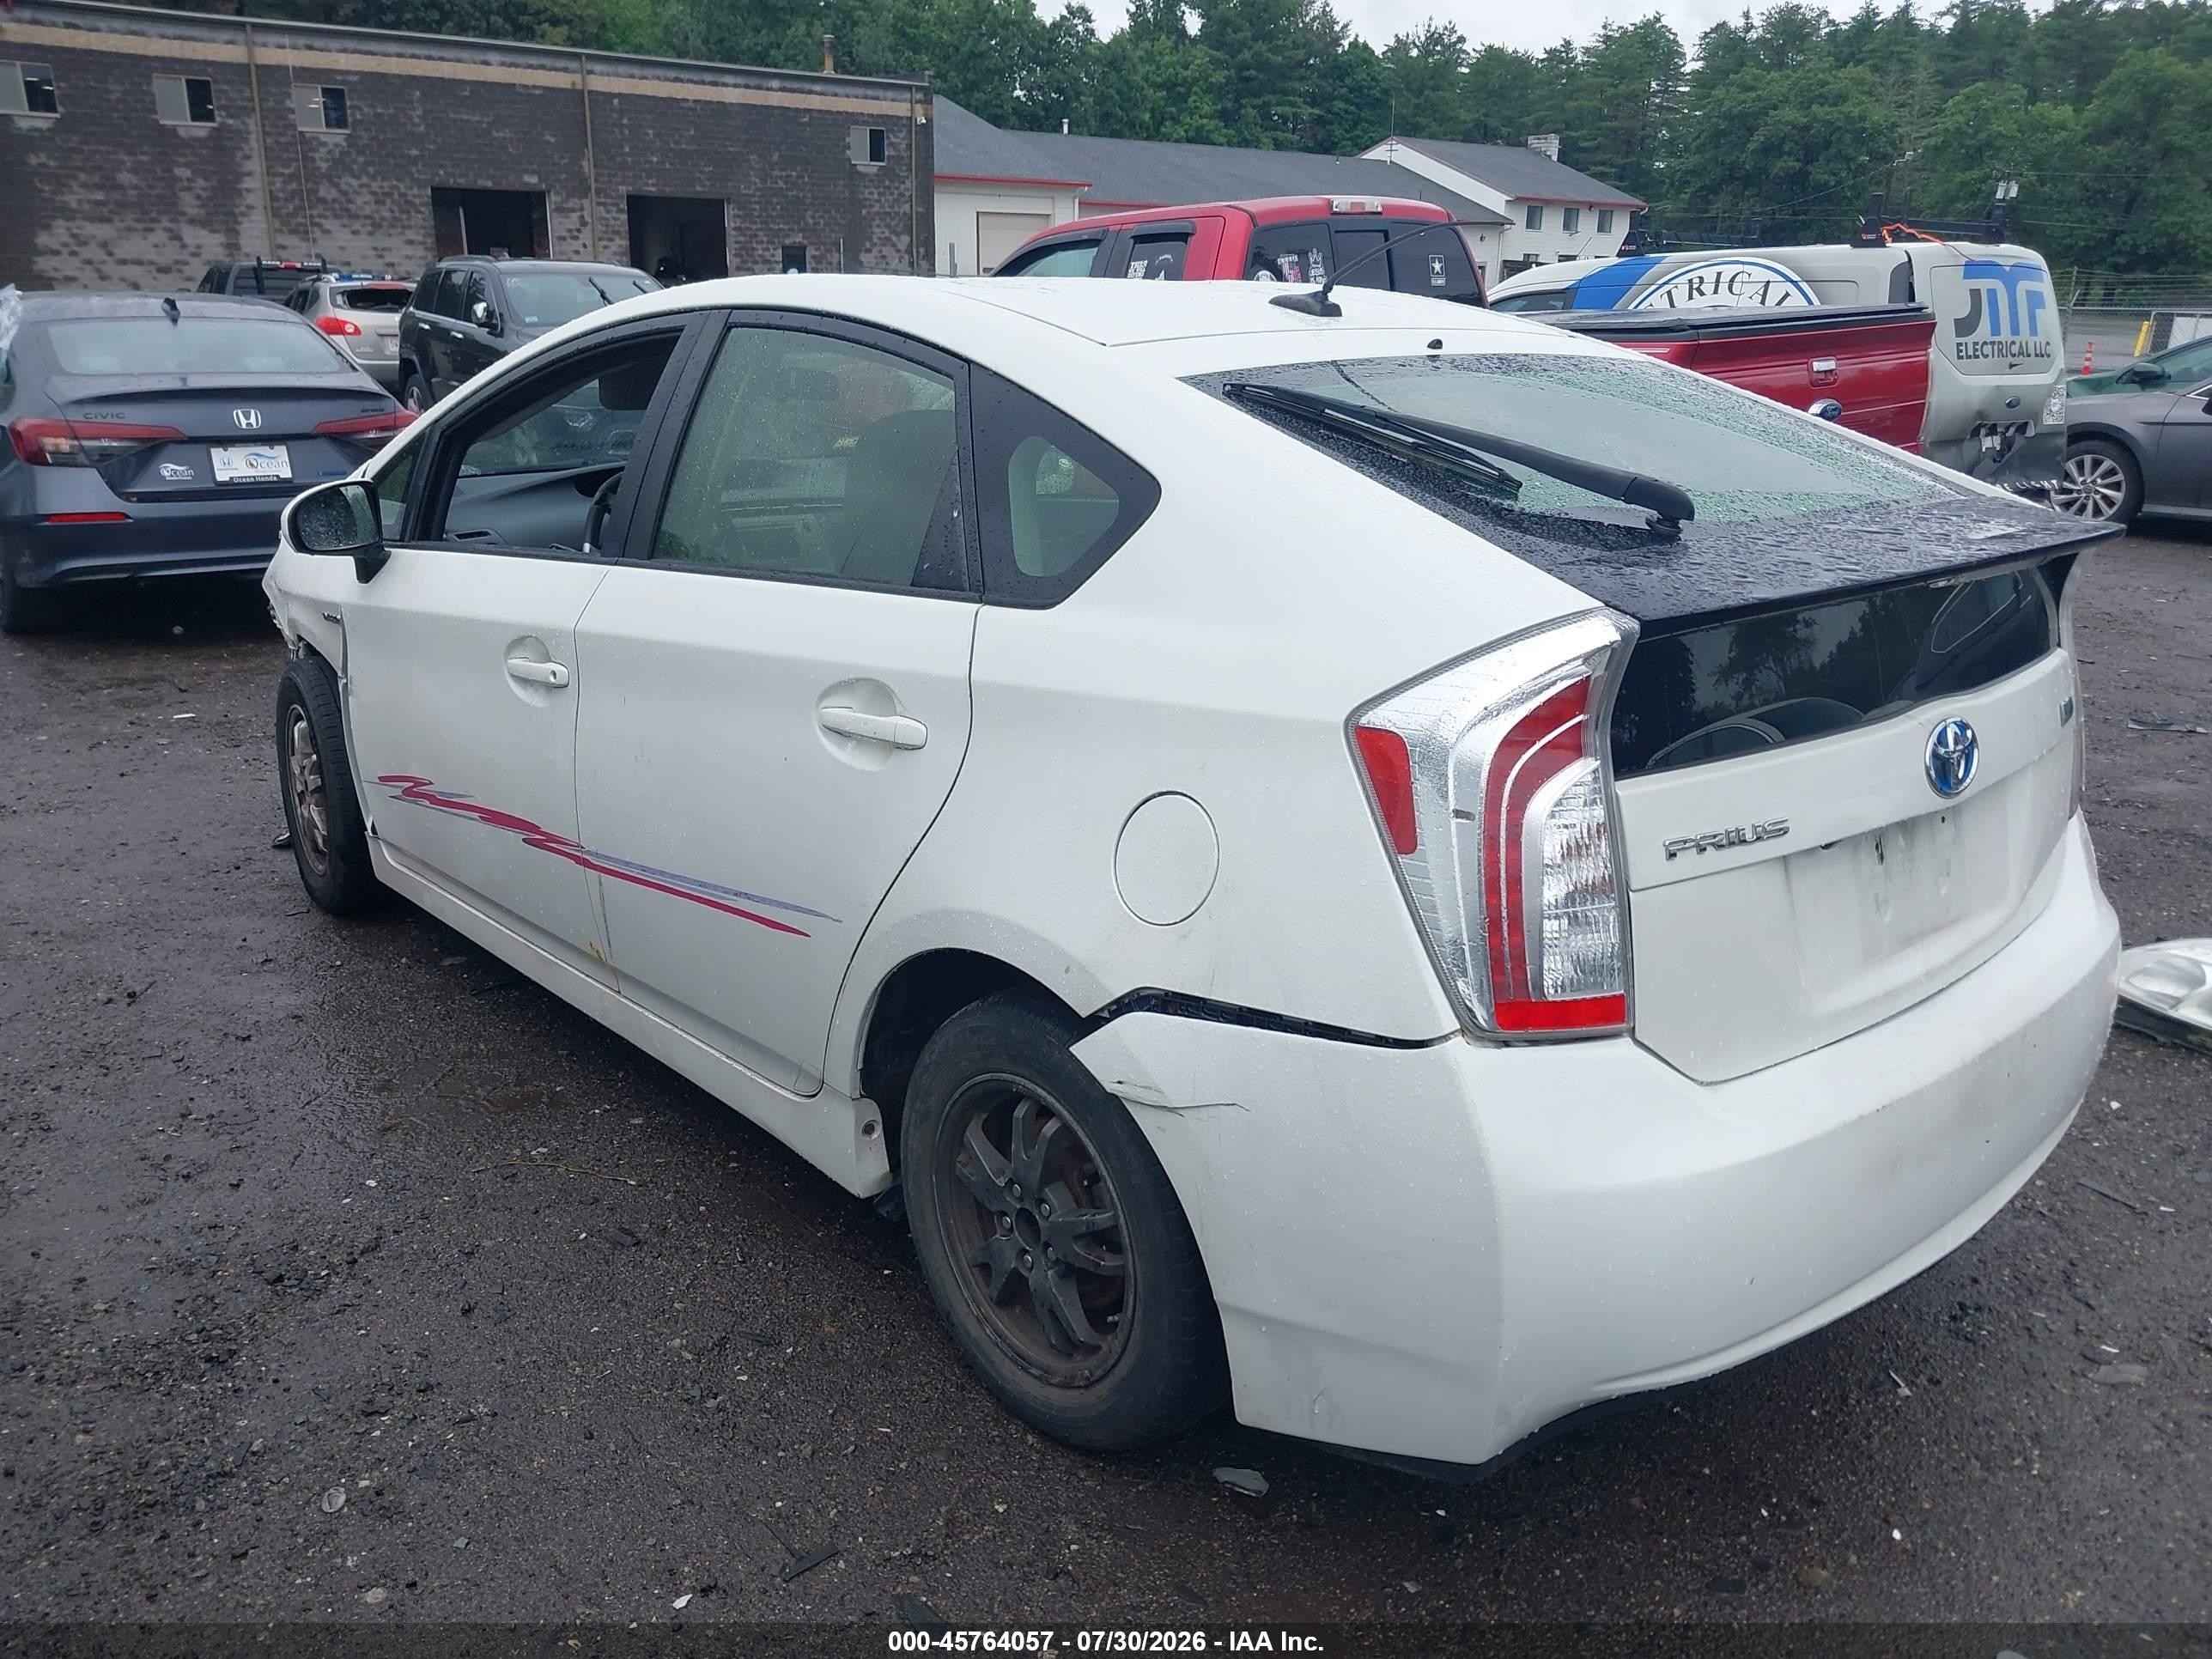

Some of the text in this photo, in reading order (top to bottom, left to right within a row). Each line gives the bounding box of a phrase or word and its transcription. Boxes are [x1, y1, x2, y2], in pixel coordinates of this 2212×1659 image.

[1956, 340, 2051, 360] ELECTRICAL LLC
[246, 458, 289, 469] Ocean
[161, 467, 195, 477] Ocean
[1662, 817, 1790, 861] PRIUS
